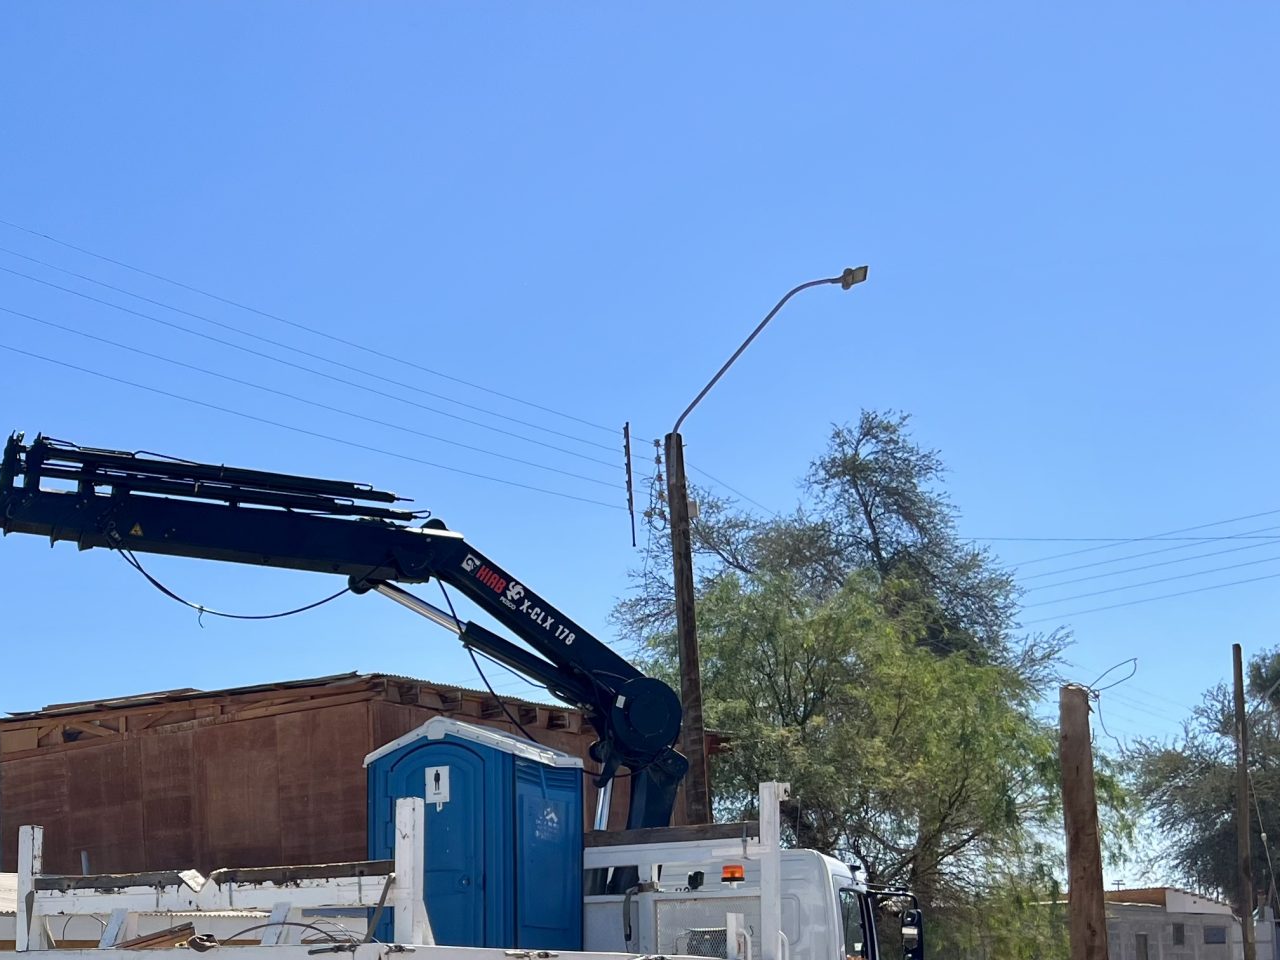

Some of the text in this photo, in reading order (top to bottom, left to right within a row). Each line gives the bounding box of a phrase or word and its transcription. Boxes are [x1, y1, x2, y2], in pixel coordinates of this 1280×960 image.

[476, 565, 506, 594] HIAB
[519, 599, 576, 645] X-CLX 178
